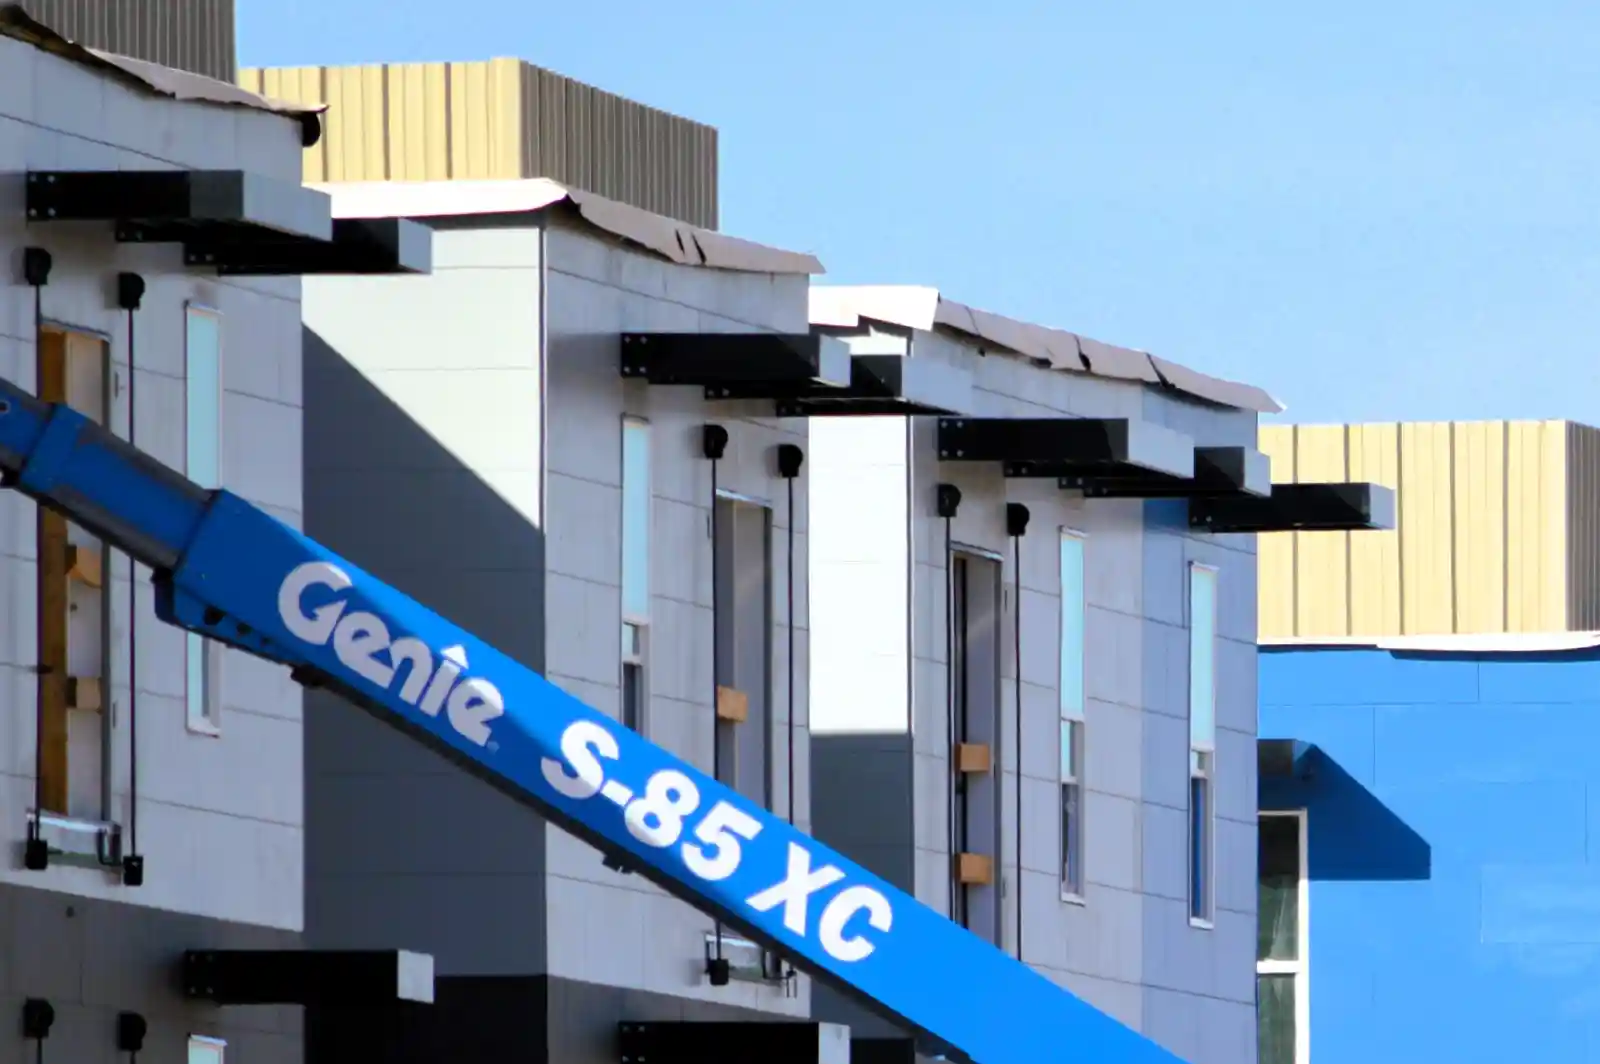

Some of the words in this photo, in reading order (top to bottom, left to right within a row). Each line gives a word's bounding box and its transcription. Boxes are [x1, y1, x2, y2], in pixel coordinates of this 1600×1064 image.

[277, 560, 505, 748] Genie
[540, 718, 764, 881] S-85
[746, 841, 894, 963] XC
